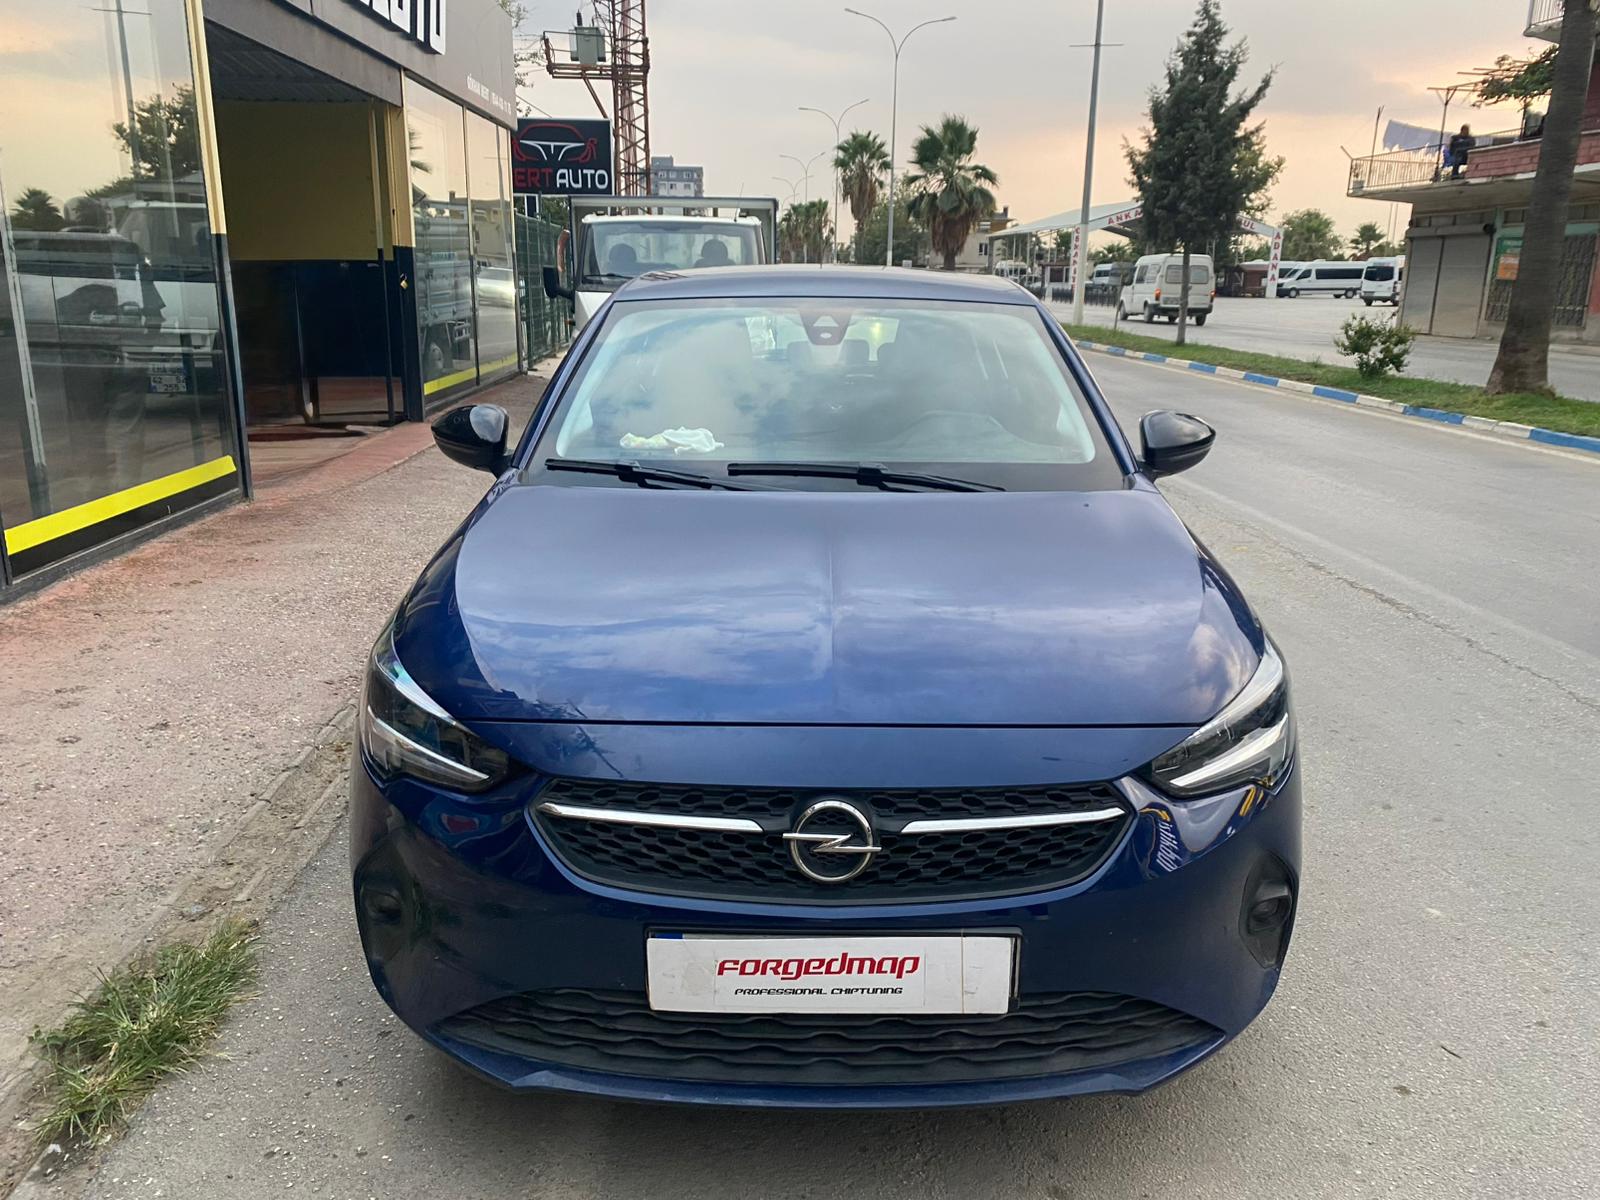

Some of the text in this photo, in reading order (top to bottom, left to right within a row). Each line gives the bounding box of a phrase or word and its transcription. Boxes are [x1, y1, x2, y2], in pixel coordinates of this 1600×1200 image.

[512, 168, 609, 189] ERT AUTO
[1269, 231, 1281, 282] ADANA
[734, 987, 903, 996] PROFESSIONAL CHIPTUNING
